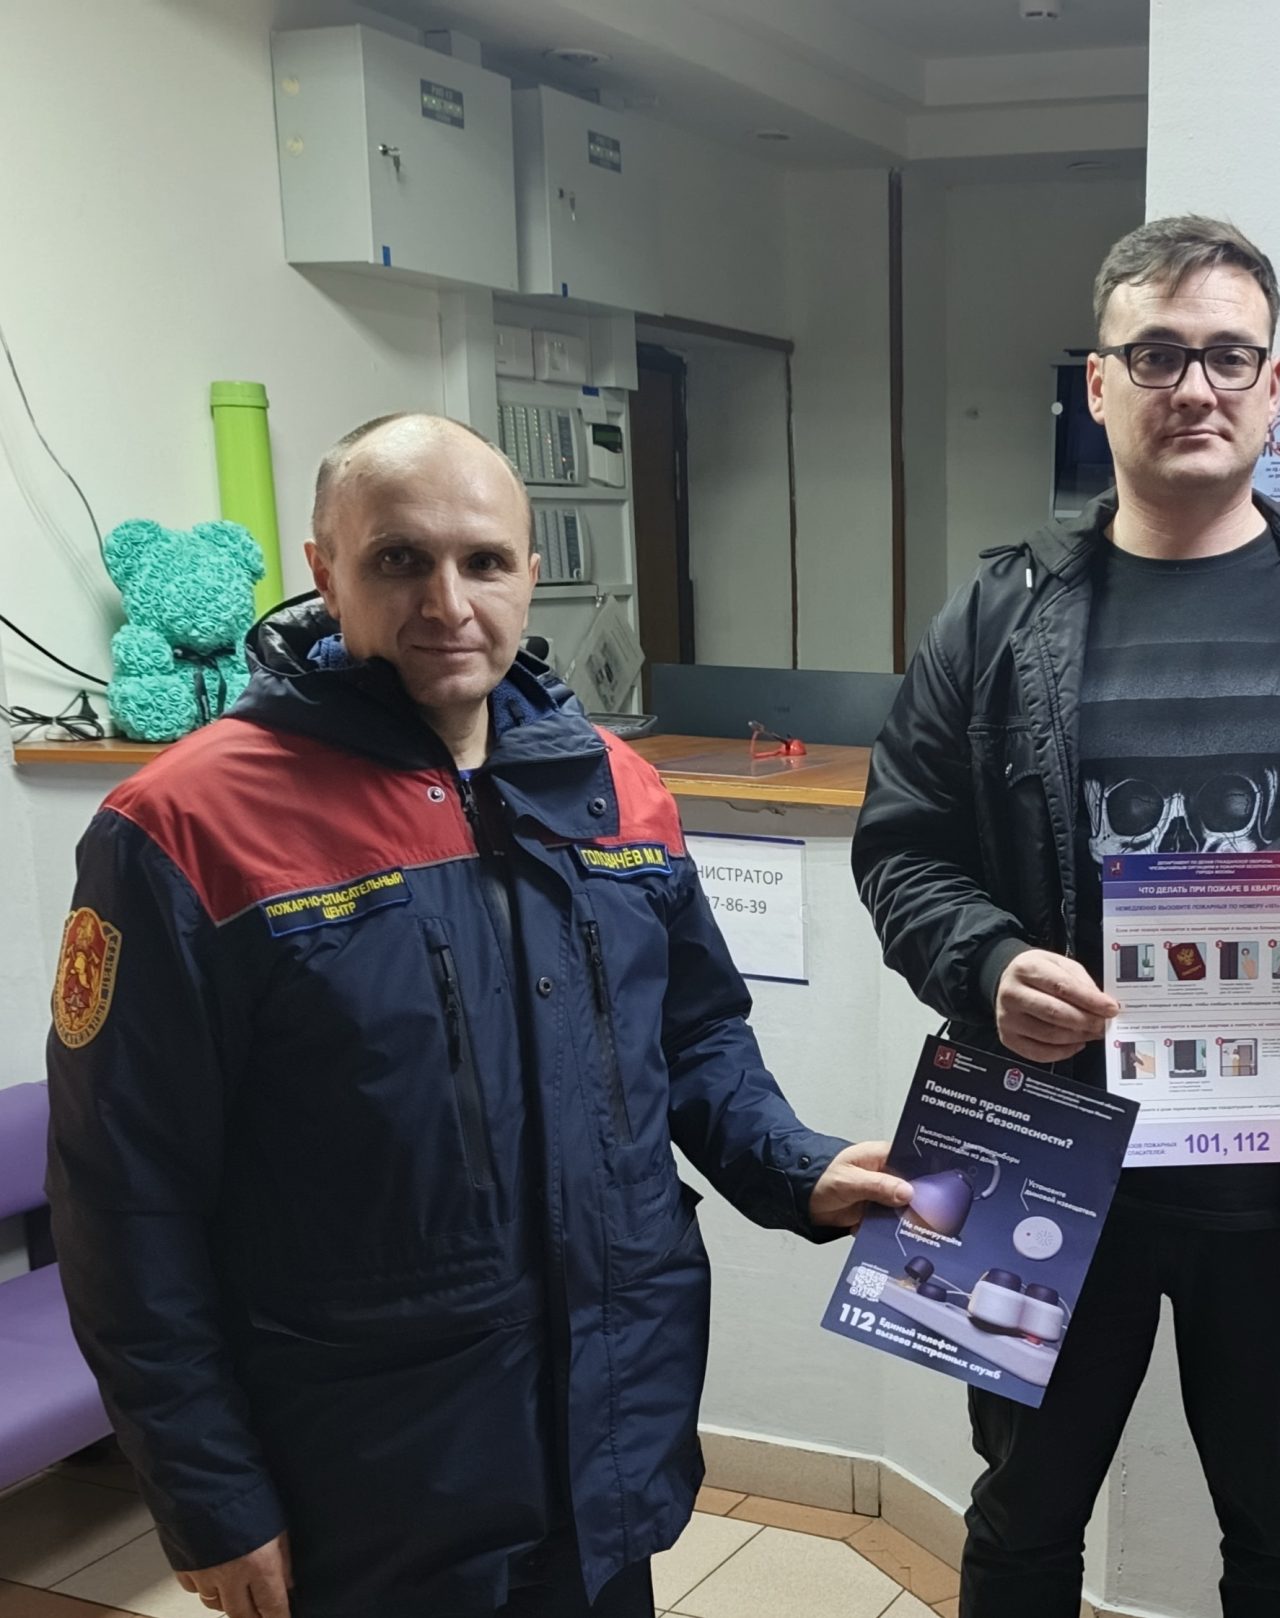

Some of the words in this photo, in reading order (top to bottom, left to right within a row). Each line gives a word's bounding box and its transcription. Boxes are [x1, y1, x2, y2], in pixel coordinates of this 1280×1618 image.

[580, 847, 644, 870] ГОЛОВАЧЁВ
[697, 865, 784, 886] НИСТРАТОР
[265, 872, 404, 918] ПОЖАРНО-СПАСАТЕЛЬНЫЙ
[1138, 886, 1155, 895] ЧТО
[1156, 886, 1188, 895] ДЕЛАТЬ
[1208, 885, 1241, 893] ПОЖАРЕ
[322, 902, 356, 920] ЦЕНТР
[705, 896, 767, 915] 7-86-39
[924, 1079, 977, 1105] Помните
[978, 1098, 1031, 1123] правила
[921, 1094, 985, 1121] пожарной
[985, 1113, 1074, 1150] безопасности?
[916, 1135, 939, 1148] перед
[939, 1141, 970, 1157] выходом
[971, 1152, 979, 1160] из
[919, 1126, 962, 1146] Выключайте
[1184, 1133, 1228, 1156] 101,
[1233, 1131, 1270, 1152] 112
[1028, 1179, 1067, 1198] Установите
[1024, 1188, 1056, 1205] дымовой
[1056, 1197, 1097, 1218] извещатель
[900, 1228, 942, 1248] электросеть
[902, 1219, 913, 1230] Не
[913, 1224, 963, 1247] перегружайте
[839, 1303, 877, 1332] 112
[879, 1317, 917, 1339] Единый
[916, 1331, 958, 1353] телефон
[875, 1329, 912, 1347] вызова
[912, 1341, 968, 1369] экстренных
[969, 1360, 1002, 1380] служб
